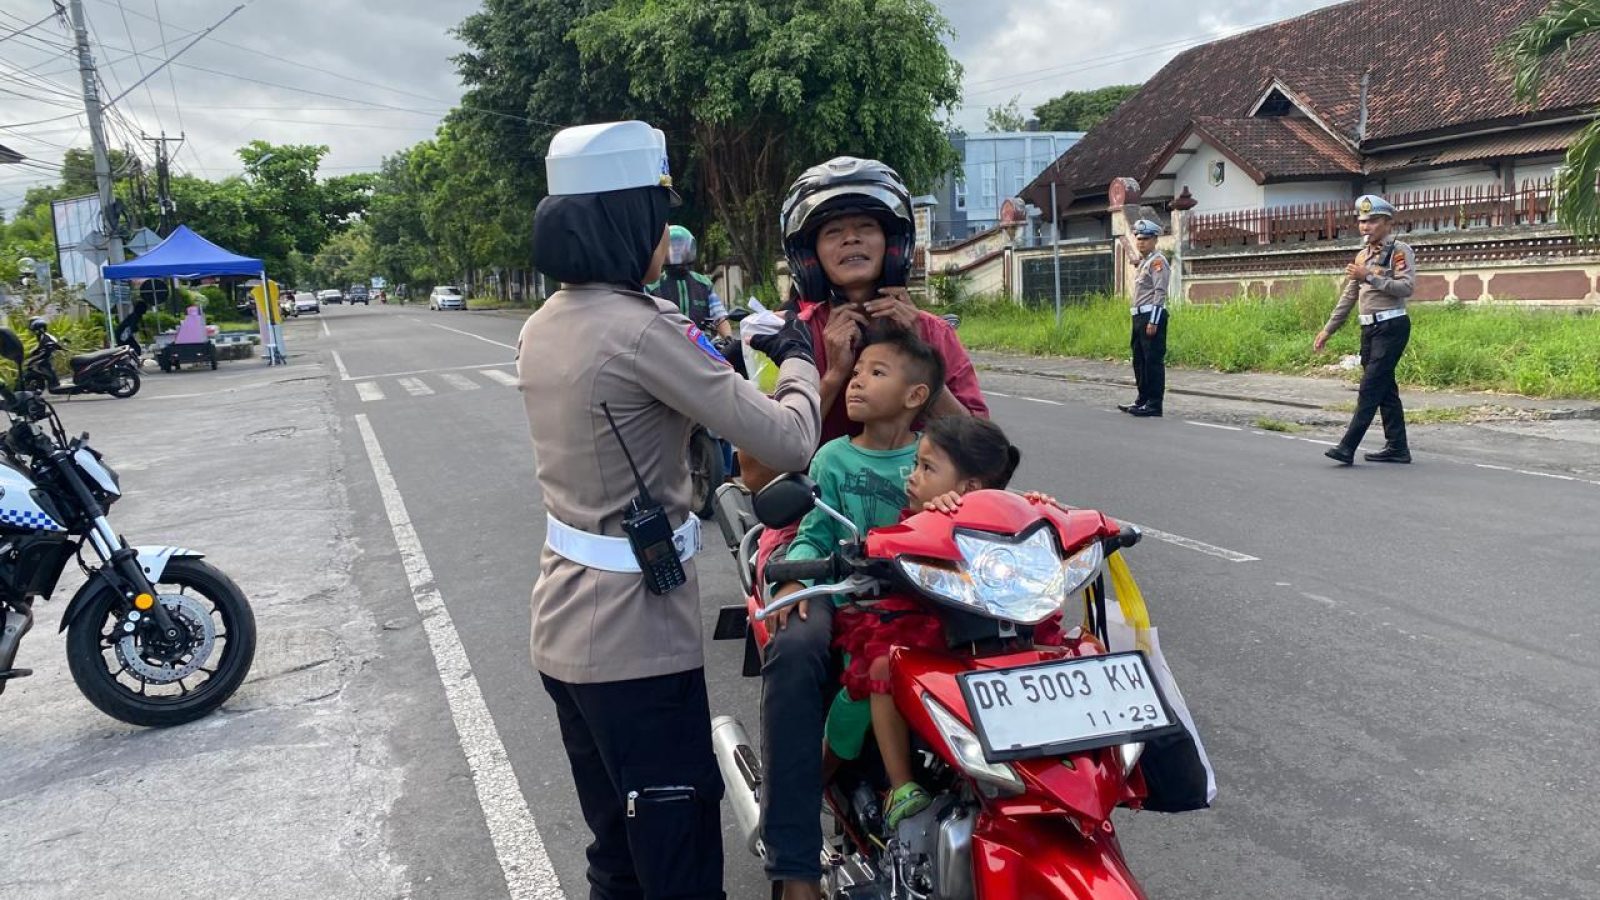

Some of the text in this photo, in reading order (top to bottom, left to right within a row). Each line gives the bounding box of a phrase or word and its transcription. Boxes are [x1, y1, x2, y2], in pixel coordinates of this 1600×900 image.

[973, 662, 1145, 710] DR 5003 KW
